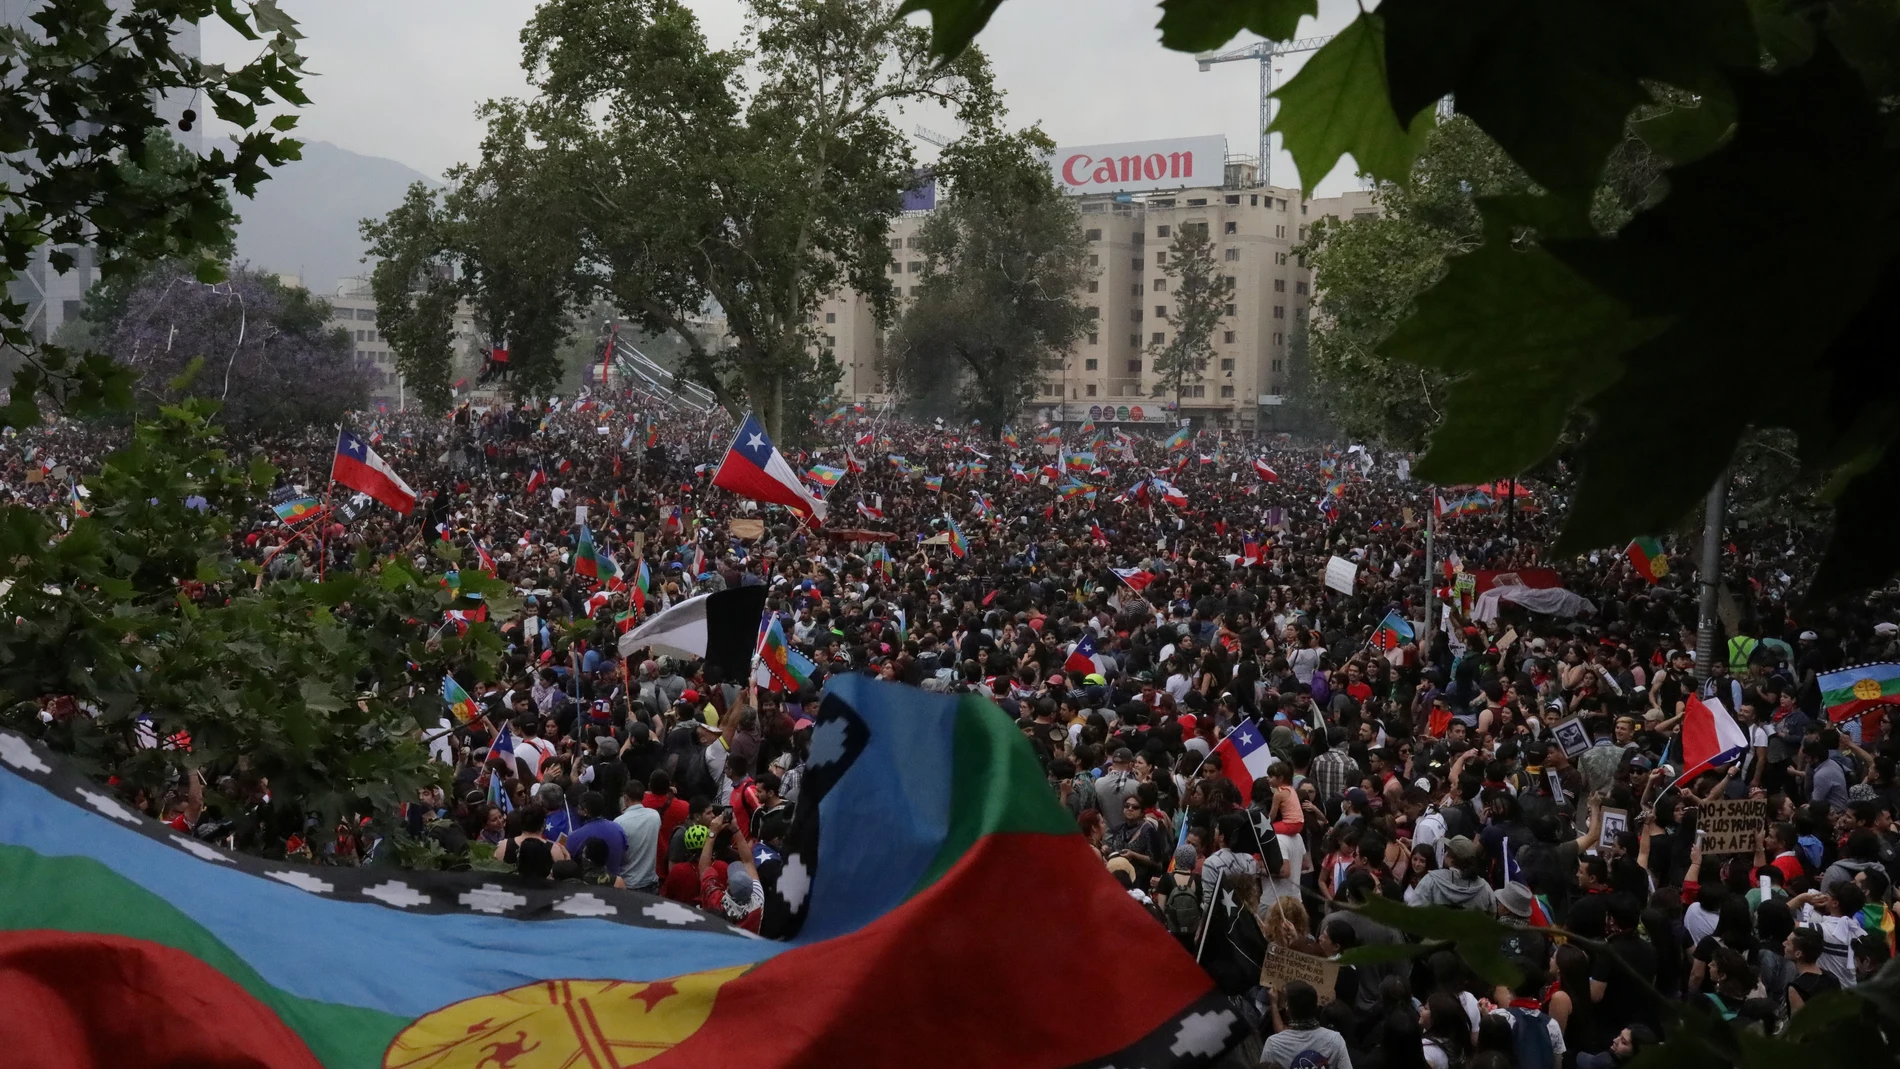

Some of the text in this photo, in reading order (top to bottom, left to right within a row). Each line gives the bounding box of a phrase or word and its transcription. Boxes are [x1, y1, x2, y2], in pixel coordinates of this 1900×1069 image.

[1062, 151, 1193, 186] Canon
[1697, 820, 1710, 833] DE
[1712, 819, 1729, 833] LOS
[1271, 945, 1286, 955] QUE
[1287, 948, 1294, 958] LA
[1264, 962, 1285, 972] QUITE
[1266, 969, 1276, 977] DE
